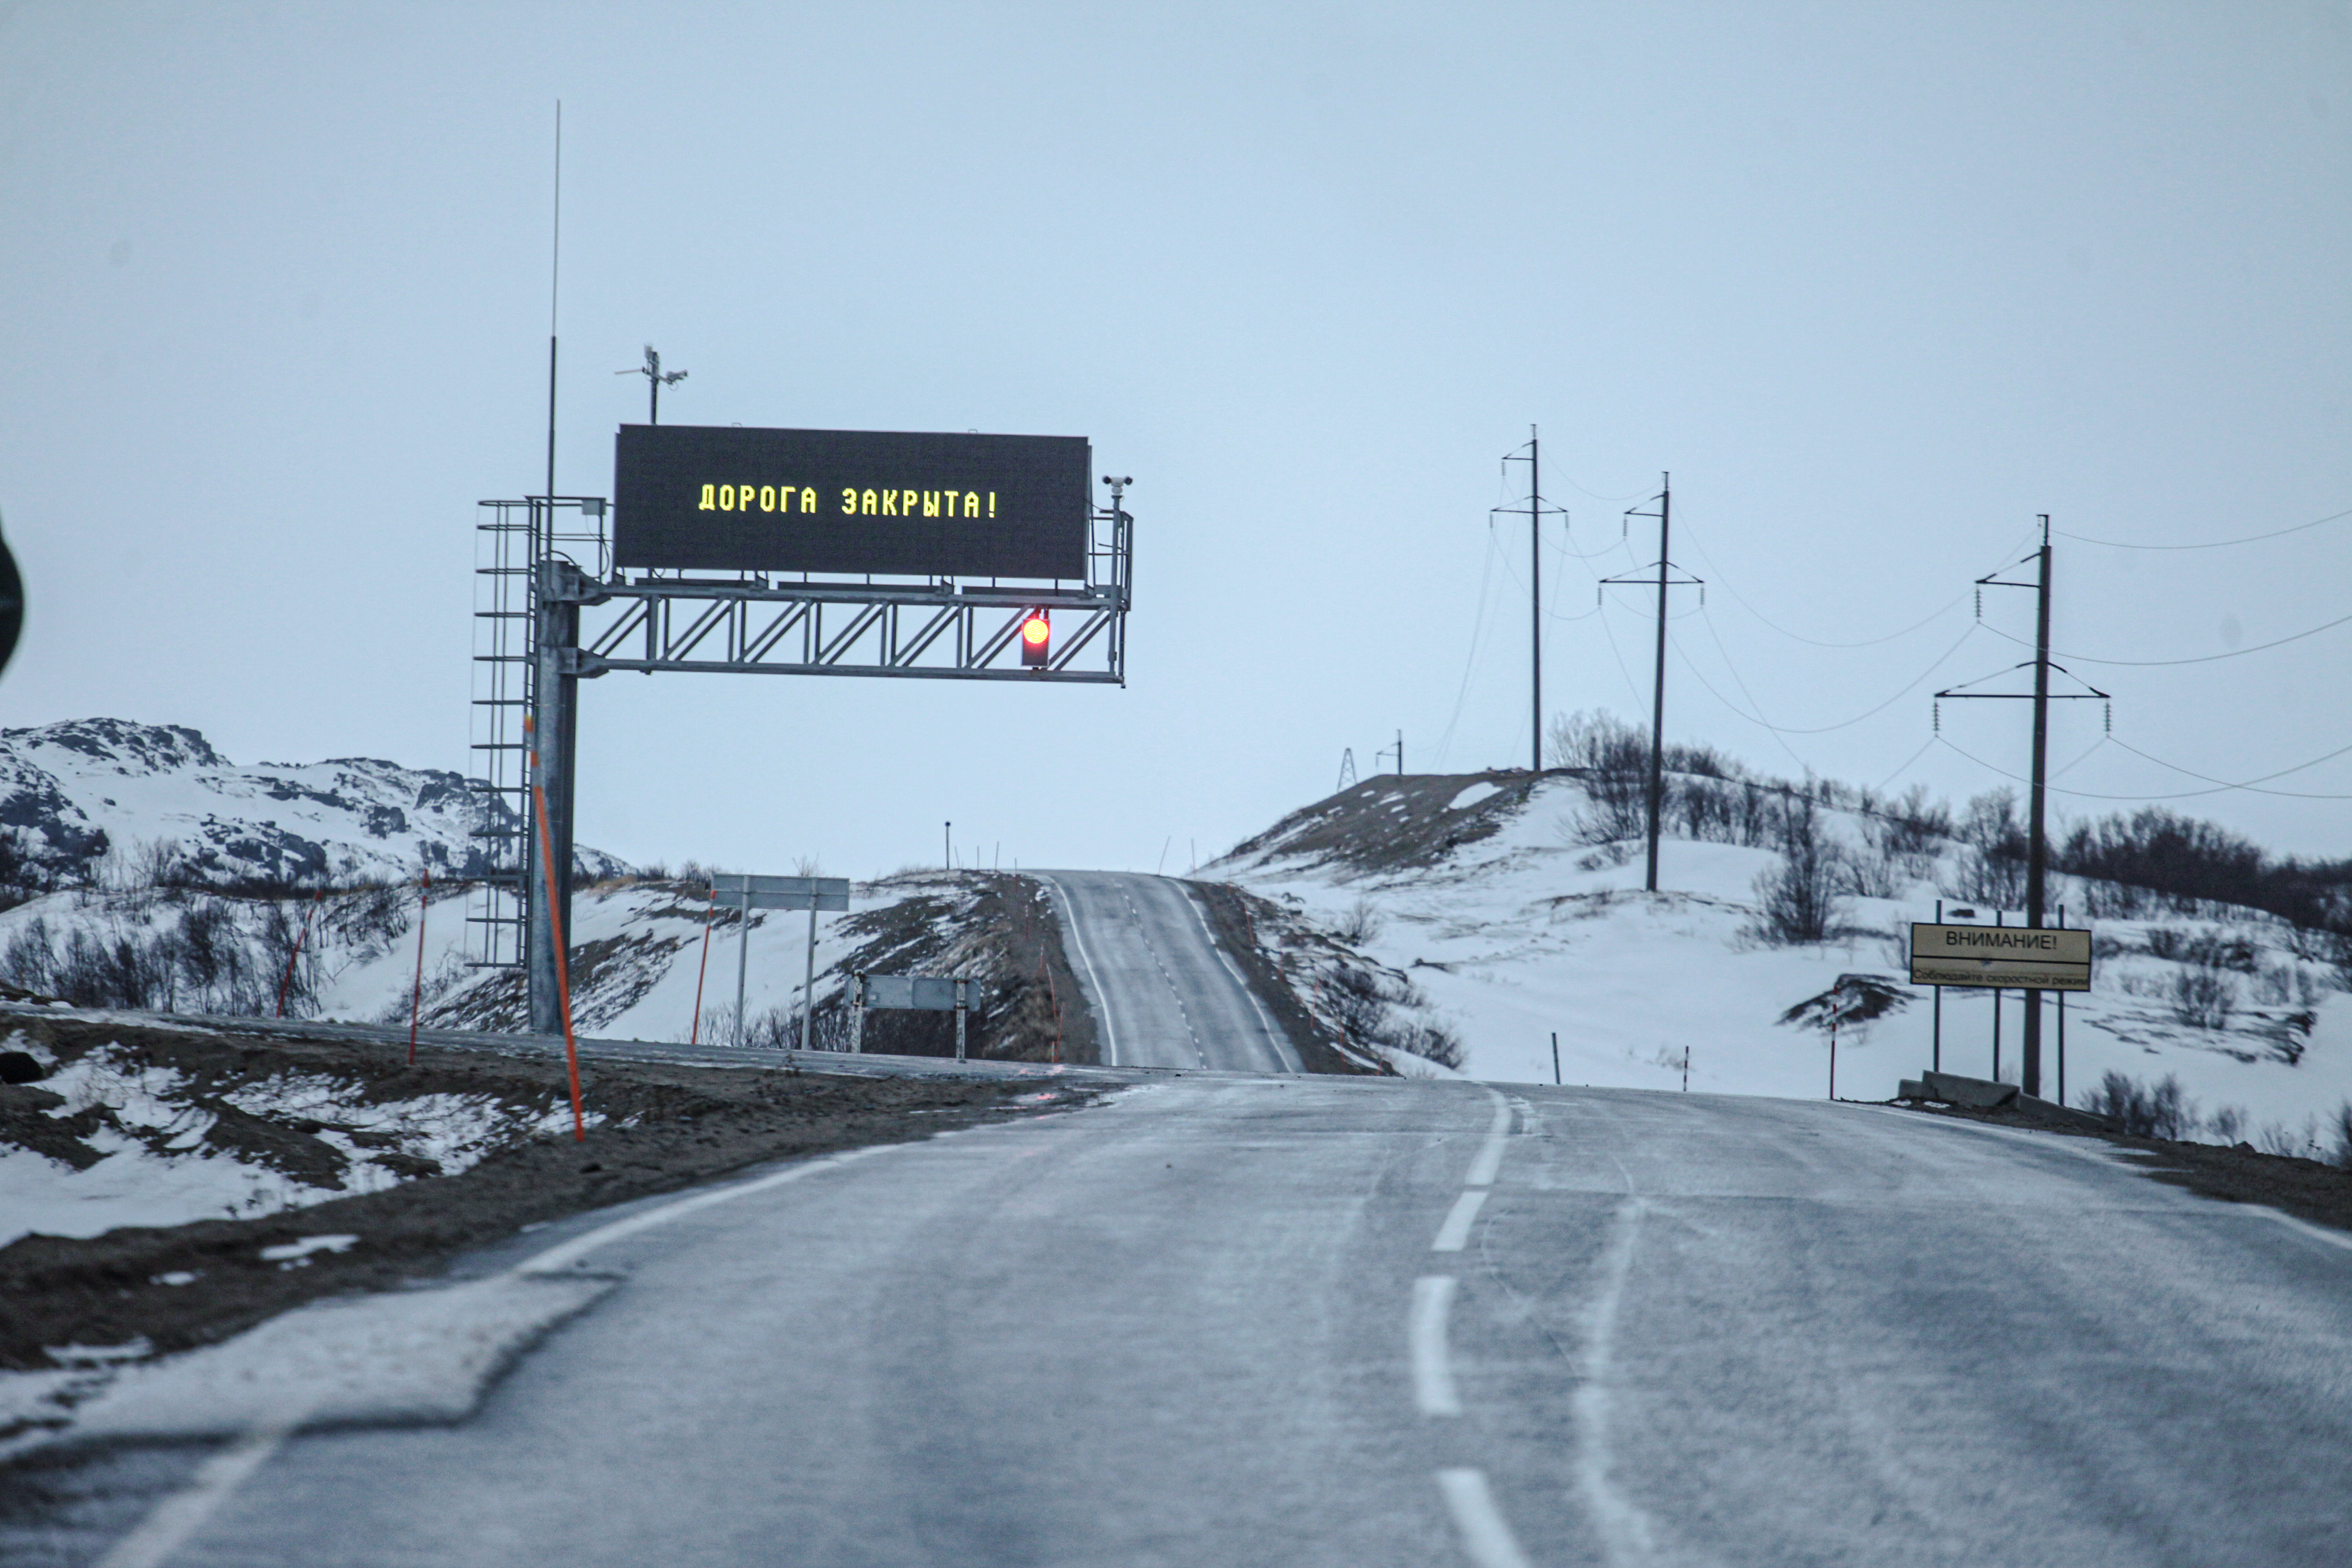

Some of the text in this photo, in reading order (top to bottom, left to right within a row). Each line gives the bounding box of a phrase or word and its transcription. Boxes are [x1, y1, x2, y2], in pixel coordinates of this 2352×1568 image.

[698, 484, 996, 518] ДОРОГА ЗАКРЫТА!
[1946, 930, 2057, 950] ВНИМАНИЕ!
[1913, 970, 1984, 982] Соблюдайте
[1987, 973, 2049, 985] скоростной
